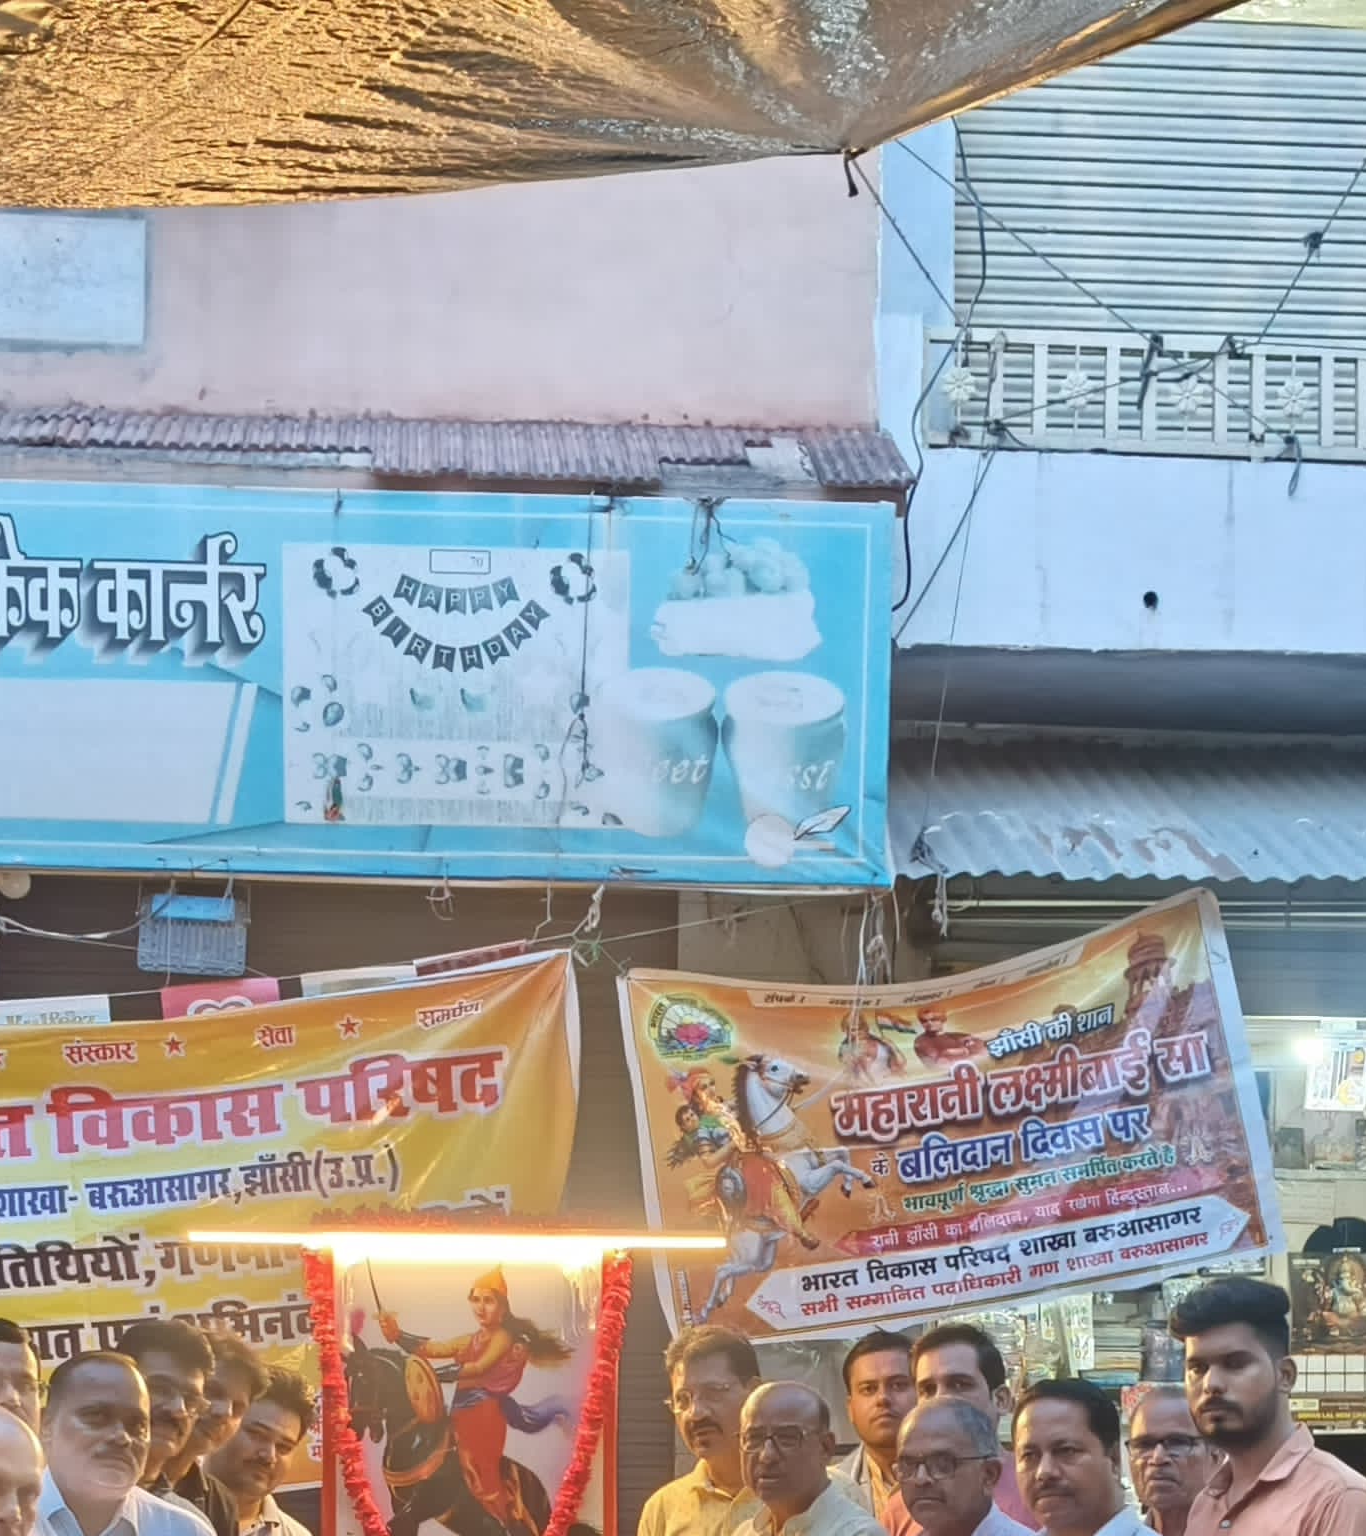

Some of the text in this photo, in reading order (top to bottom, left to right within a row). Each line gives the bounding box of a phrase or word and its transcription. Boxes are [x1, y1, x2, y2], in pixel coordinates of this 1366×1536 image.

[91, 528, 267, 648] कार्नर
[397, 577, 516, 609] HAPPY
[368, 600, 544, 669] BIRTHDAY
[64, 1038, 136, 1064] संस्कार
[256, 1024, 295, 1048] सेवा
[1045, 1016, 1073, 1046] की
[1076, 1005, 1115, 1033] शान
[46, 1084, 284, 1155] विकास
[295, 1049, 504, 1125] परिषद
[830, 1061, 985, 1145] महारानी
[870, 1104, 1151, 1183] के बलिदान दिवस पर
[800, 1268, 860, 1294] भारत
[865, 1255, 938, 1284] विकास
[943, 1243, 1012, 1270] परिषद
[1018, 1231, 1077, 1257] शाखा
[800, 1294, 839, 1317] सभी
[1027, 1259, 1060, 1280] गण
[1066, 1250, 1114, 1272] शाखा
